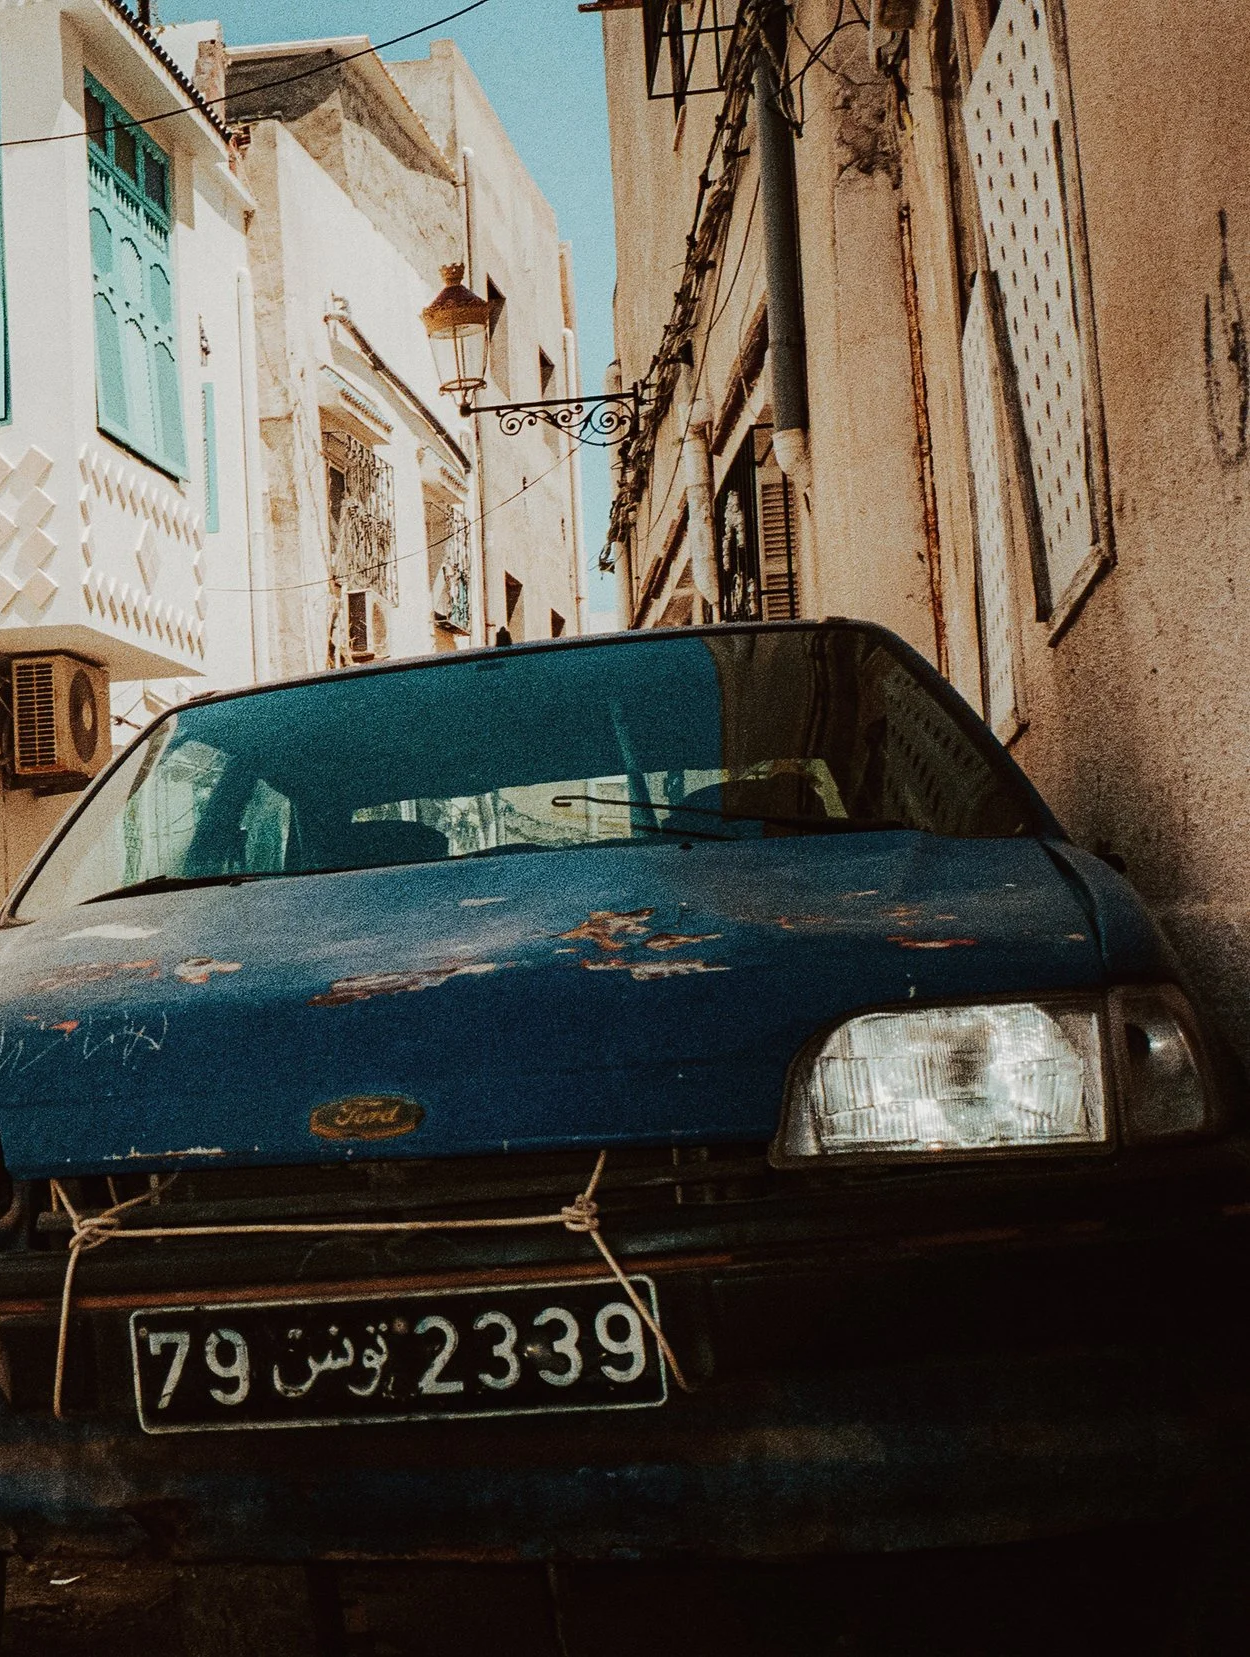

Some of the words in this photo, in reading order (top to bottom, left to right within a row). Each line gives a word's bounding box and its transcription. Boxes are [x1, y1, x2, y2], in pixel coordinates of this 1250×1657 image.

[334, 1101, 400, 1126] Ford
[150, 1328, 250, 1409] 79
[272, 1322, 390, 1398] تونس
[414, 1301, 646, 1395] 2339
